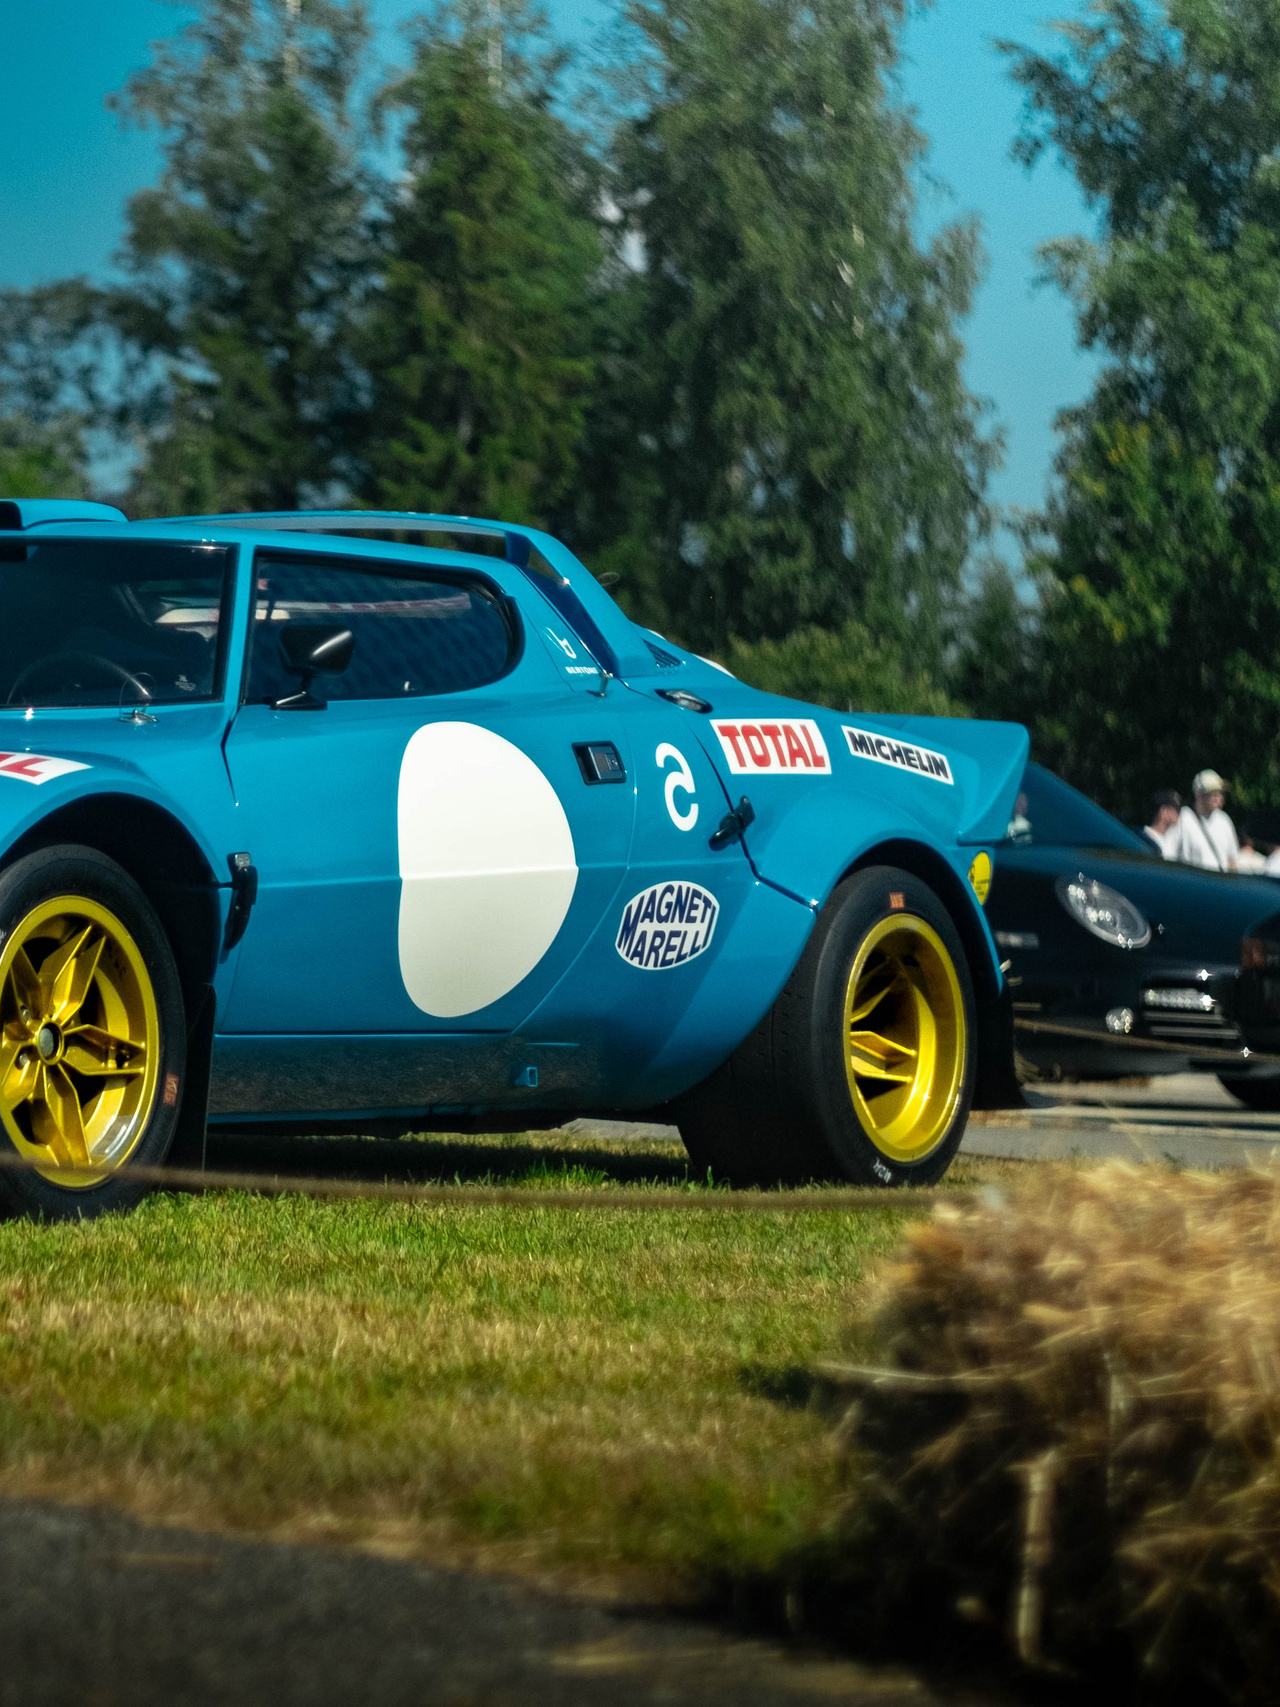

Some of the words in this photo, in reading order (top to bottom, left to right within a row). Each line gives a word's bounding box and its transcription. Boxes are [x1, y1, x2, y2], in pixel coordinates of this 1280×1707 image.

[717, 725, 826, 767] TOTAL
[847, 730, 950, 779] MICHELIN
[618, 884, 717, 936] MAGNETI
[617, 922, 712, 968] MARELLI
